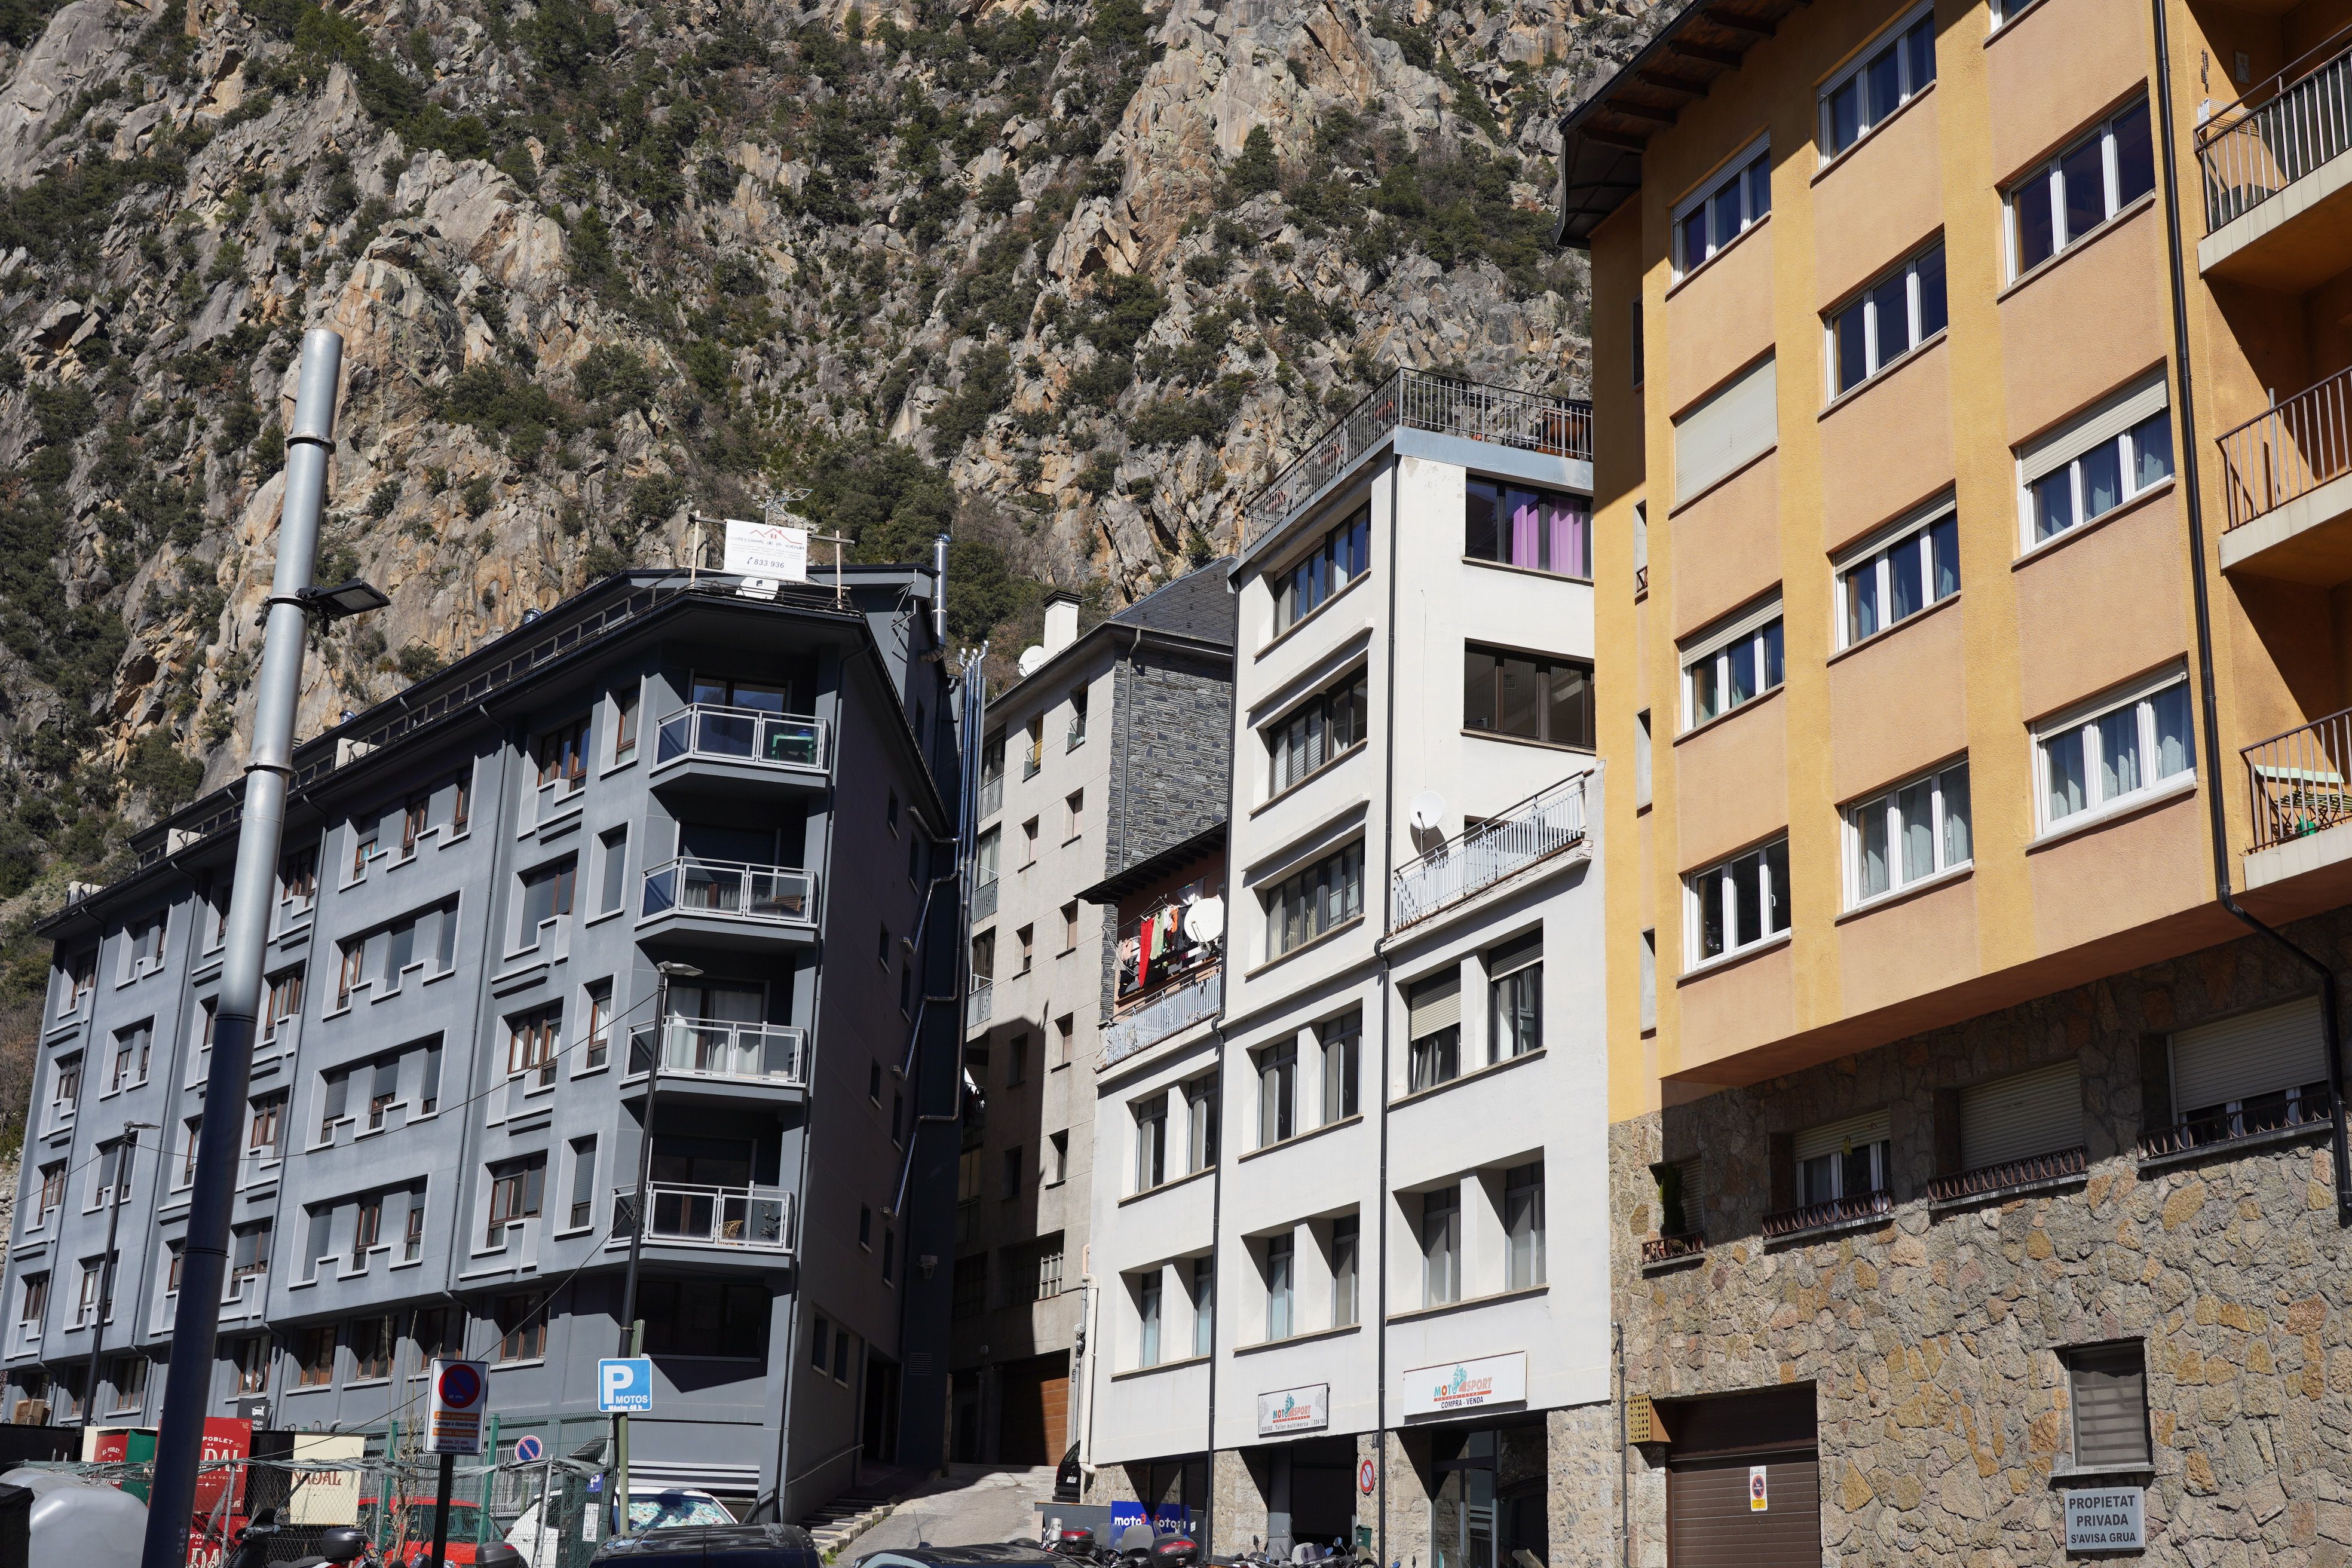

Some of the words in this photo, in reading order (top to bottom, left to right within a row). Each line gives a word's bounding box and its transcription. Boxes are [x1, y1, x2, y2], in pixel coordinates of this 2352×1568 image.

[604, 1365, 633, 1404] P
[615, 1395, 648, 1404] MOTOS
[1441, 1399, 1462, 1409] COMPRA
[1466, 1396, 1483, 1404] VENDA
[203, 1437, 234, 1445] POBLET
[2069, 1495, 2135, 1509] PROPIETAT
[2077, 1514, 2129, 1527] PRIVADA
[2071, 1533, 2106, 1543] S'AVISA
[2109, 1532, 2136, 1542] GRUA
